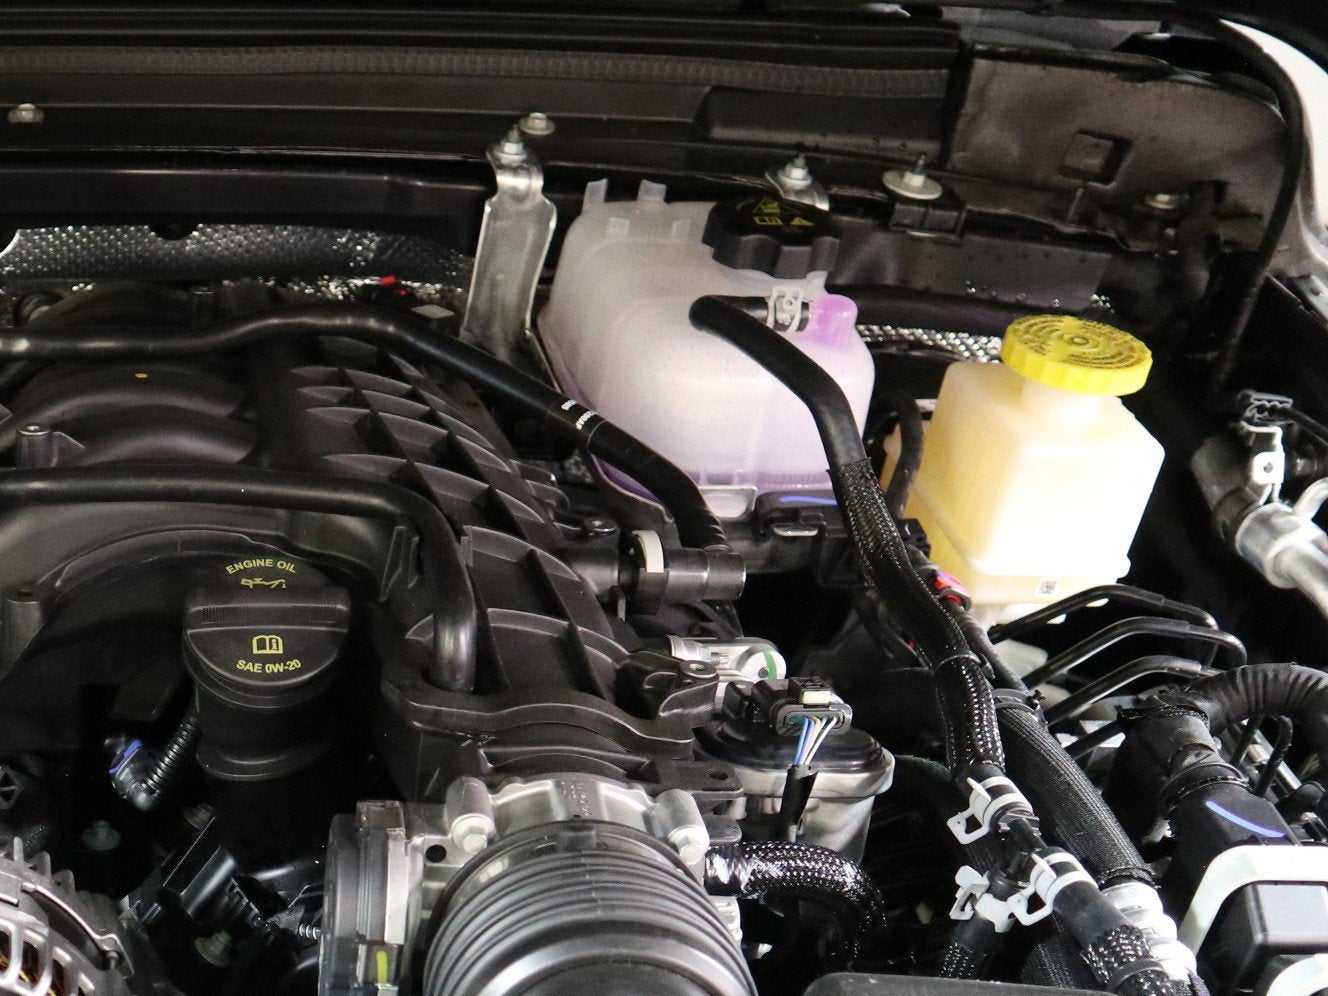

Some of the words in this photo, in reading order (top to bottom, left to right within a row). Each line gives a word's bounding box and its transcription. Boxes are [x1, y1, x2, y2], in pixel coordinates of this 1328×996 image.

[225, 558, 274, 575] ENGINE
[276, 560, 297, 574] OIL
[236, 658, 263, 673] SAE
[264, 658, 302, 673] 0W-20
